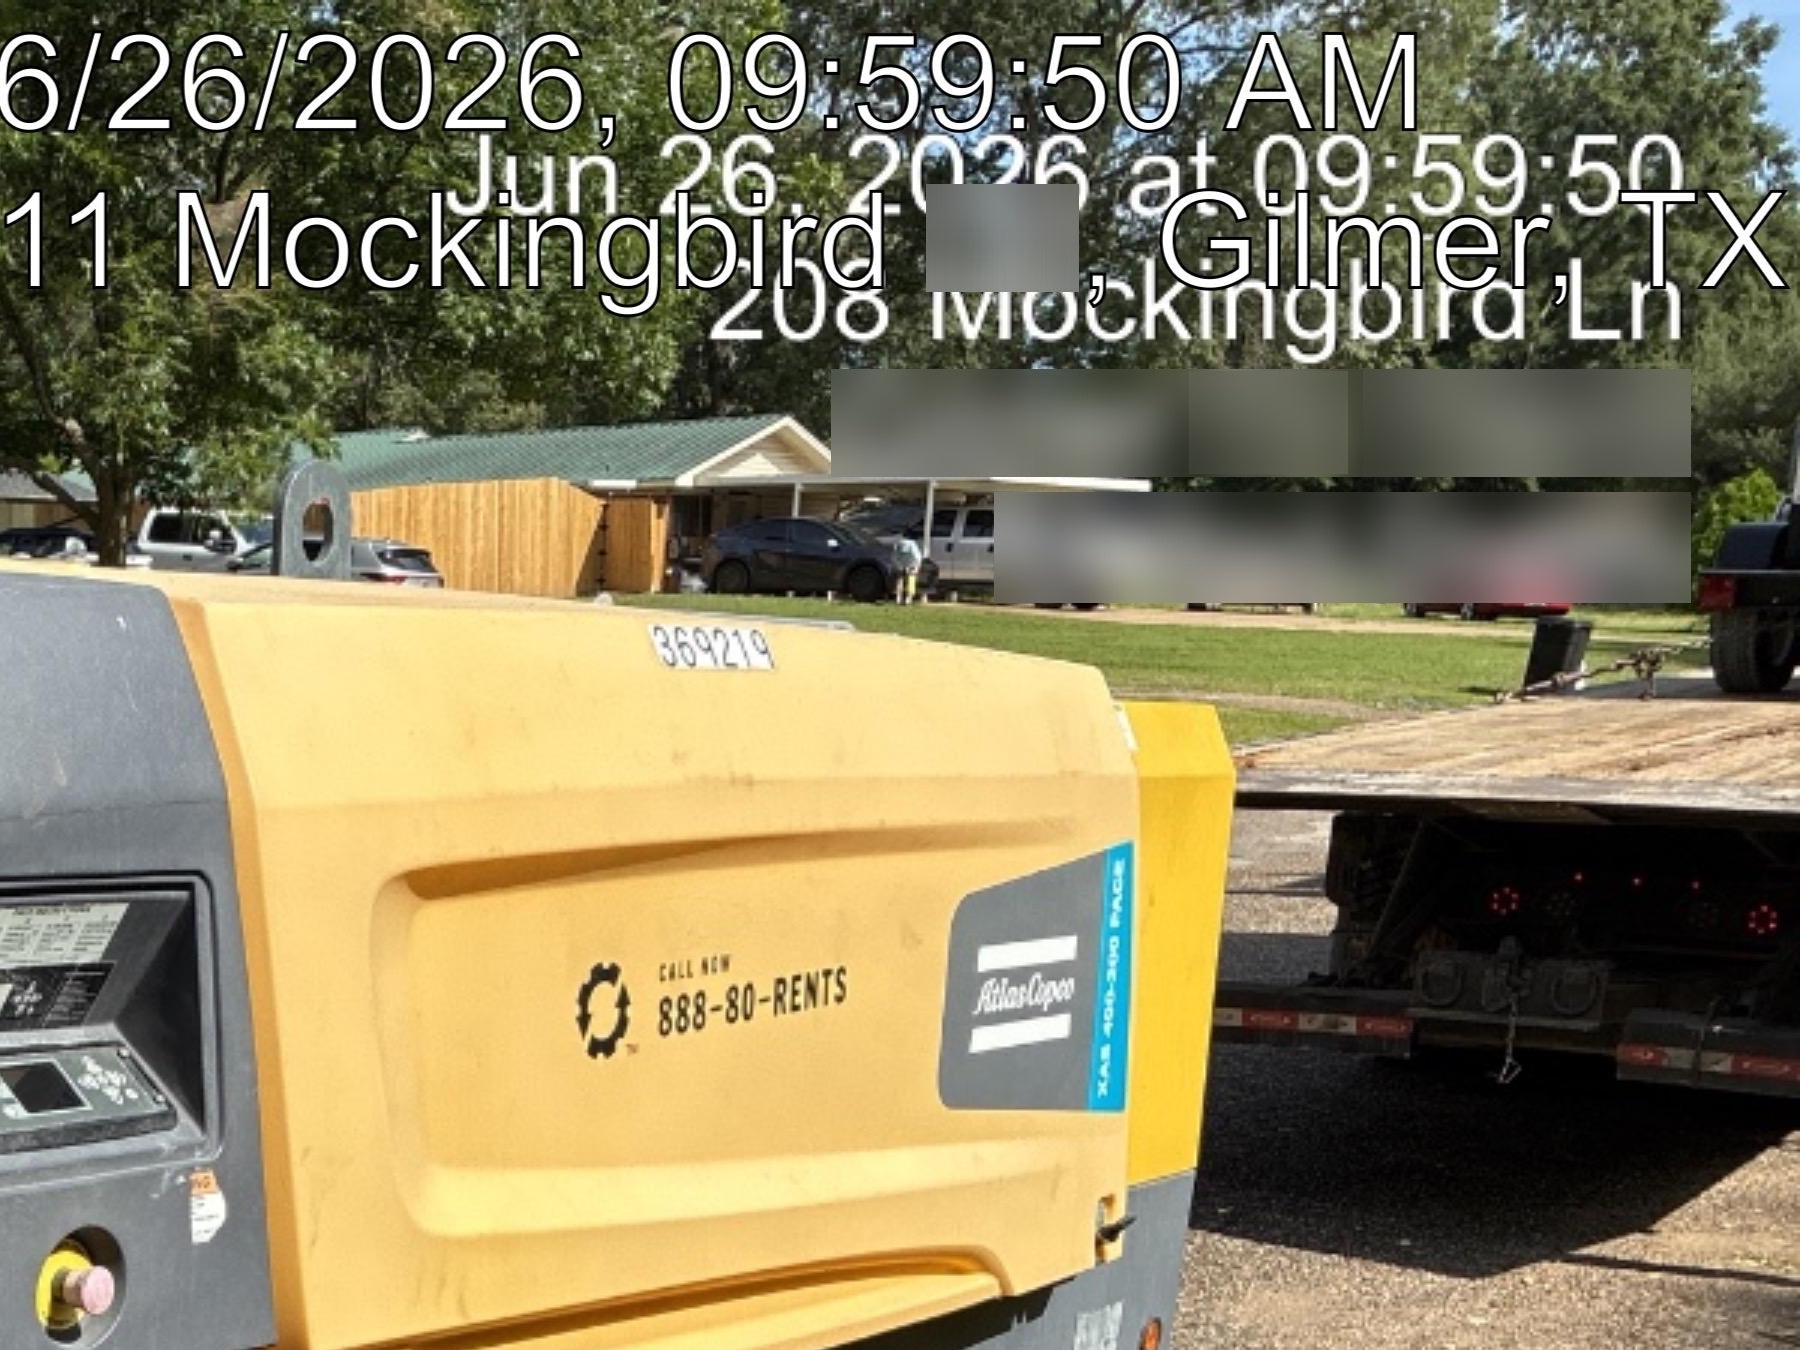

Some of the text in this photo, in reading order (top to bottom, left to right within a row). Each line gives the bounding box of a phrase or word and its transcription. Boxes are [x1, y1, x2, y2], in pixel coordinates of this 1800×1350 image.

[653, 625, 775, 670] 369219
[658, 953, 732, 982] CALL NOW
[657, 965, 848, 1037] 888-80-RENTS
